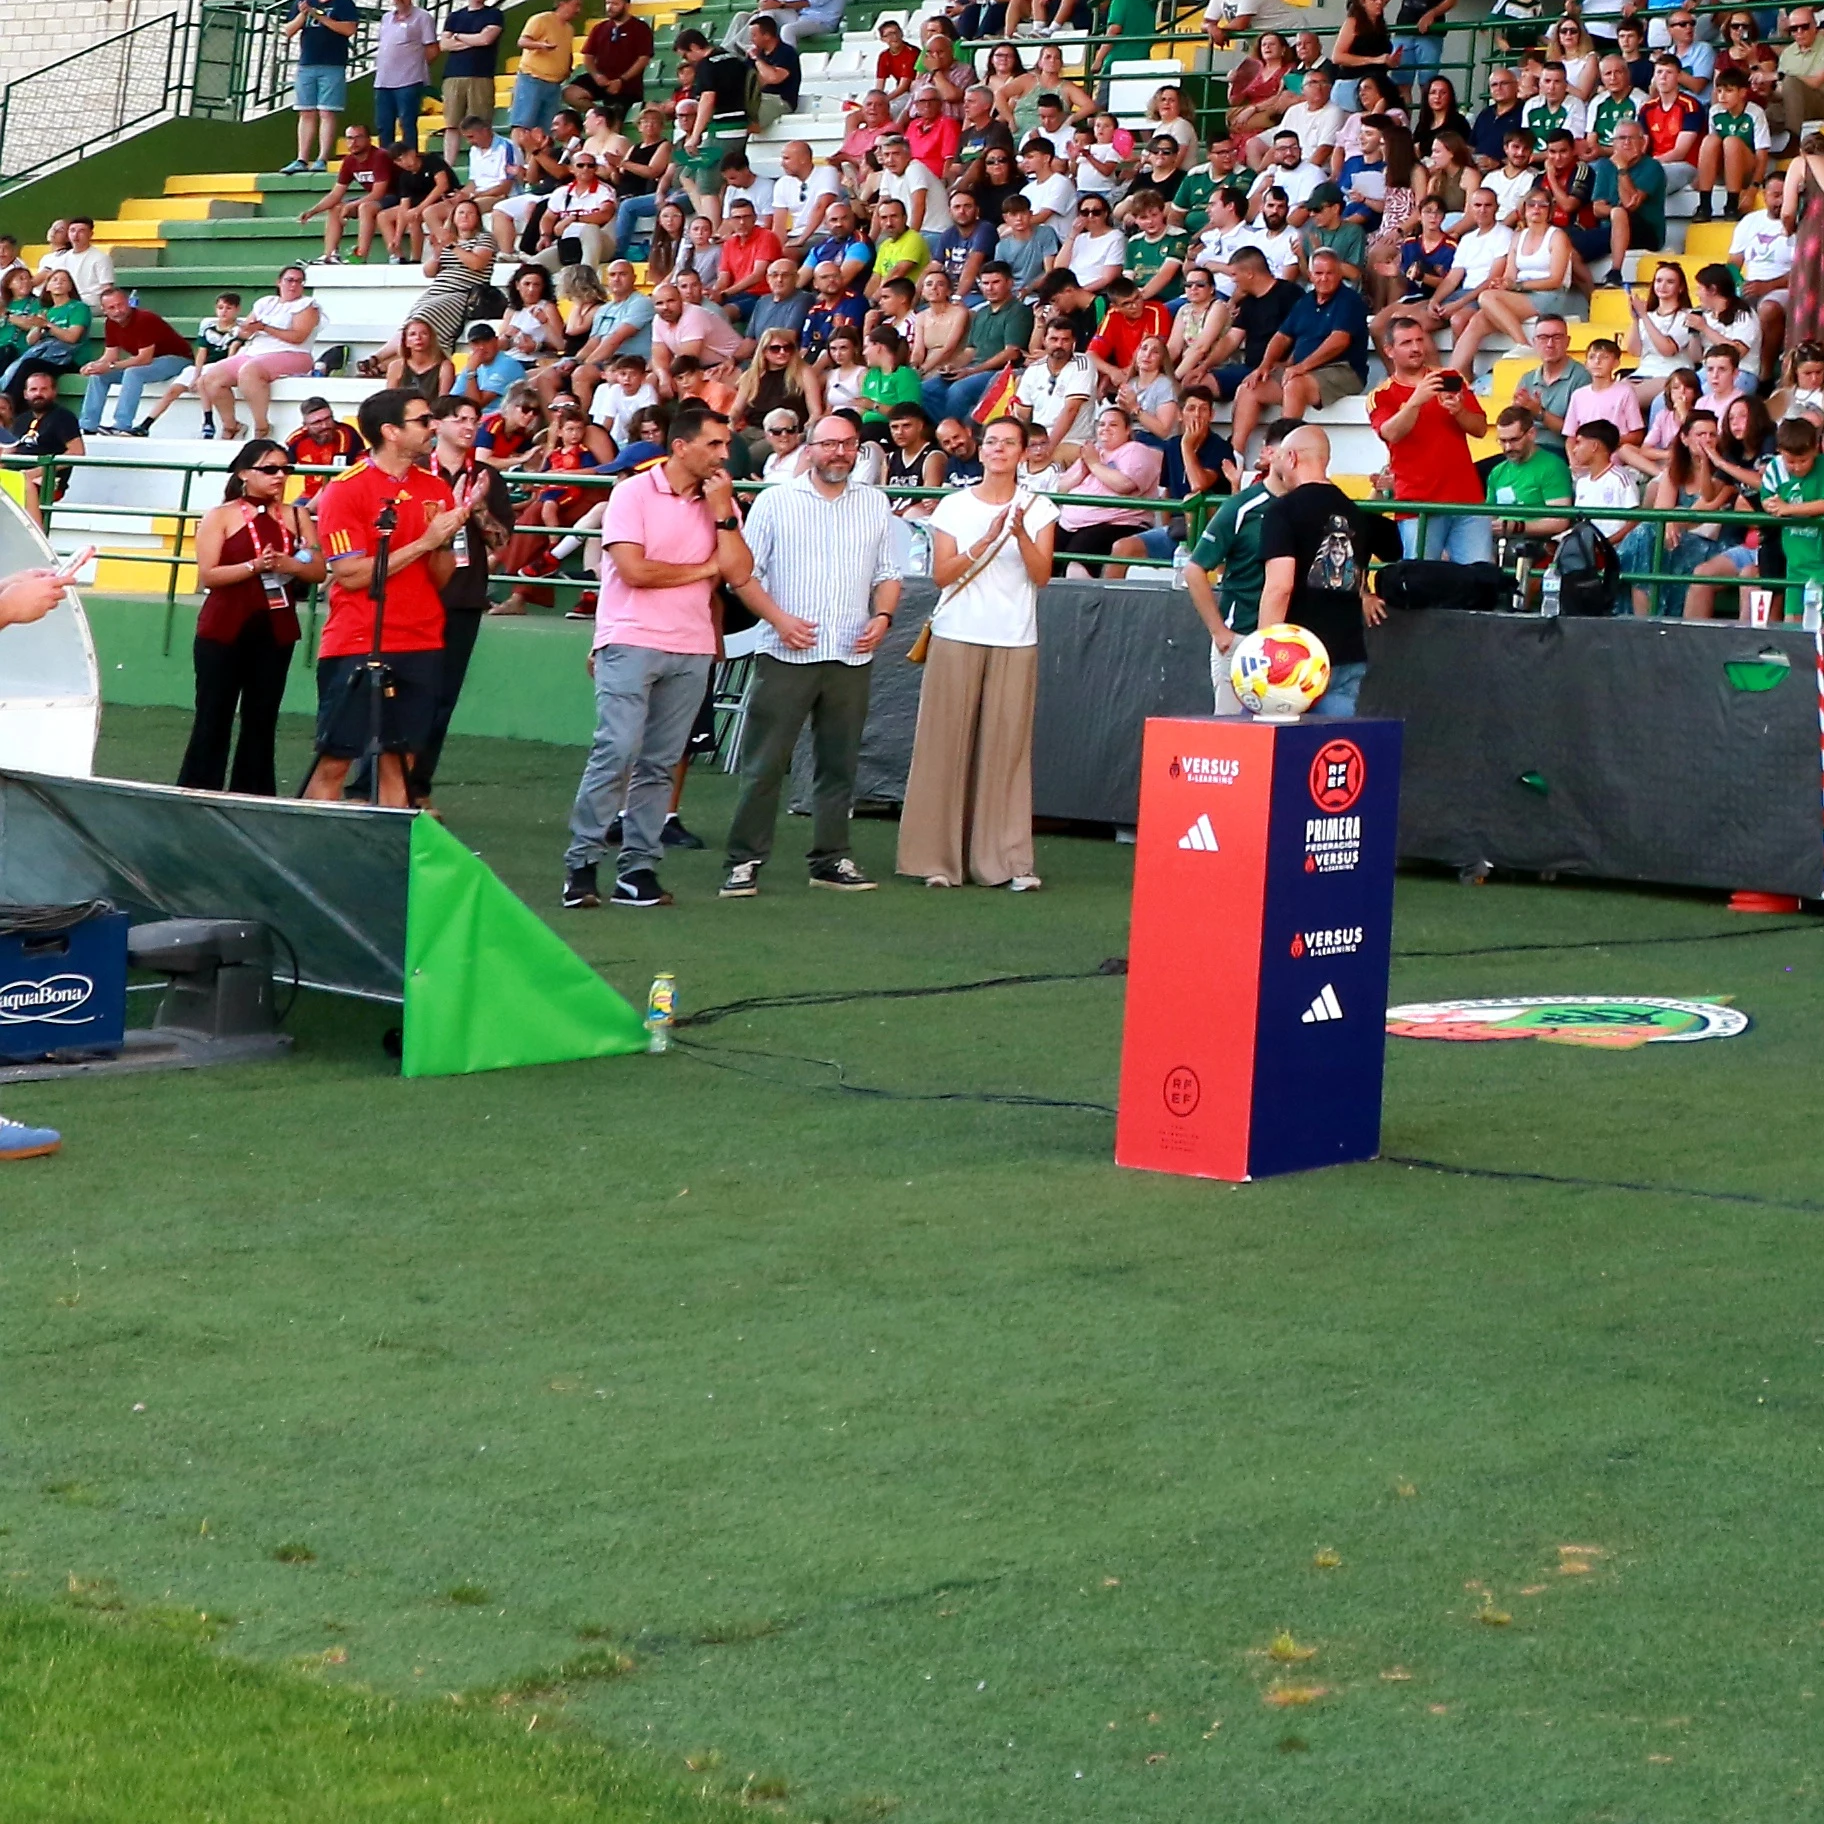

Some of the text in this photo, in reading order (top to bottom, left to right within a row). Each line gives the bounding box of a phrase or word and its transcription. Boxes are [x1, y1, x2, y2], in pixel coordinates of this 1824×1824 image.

[1181, 756, 1240, 776] VERSUS
[1328, 763, 1347, 776] RF
[1327, 776, 1346, 788] EF
[1306, 816, 1360, 843] PRIMERA
[1305, 840, 1360, 852] FEDERACIÓN
[1315, 851, 1359, 866] VERSUS
[1304, 926, 1363, 948] VERSUS
